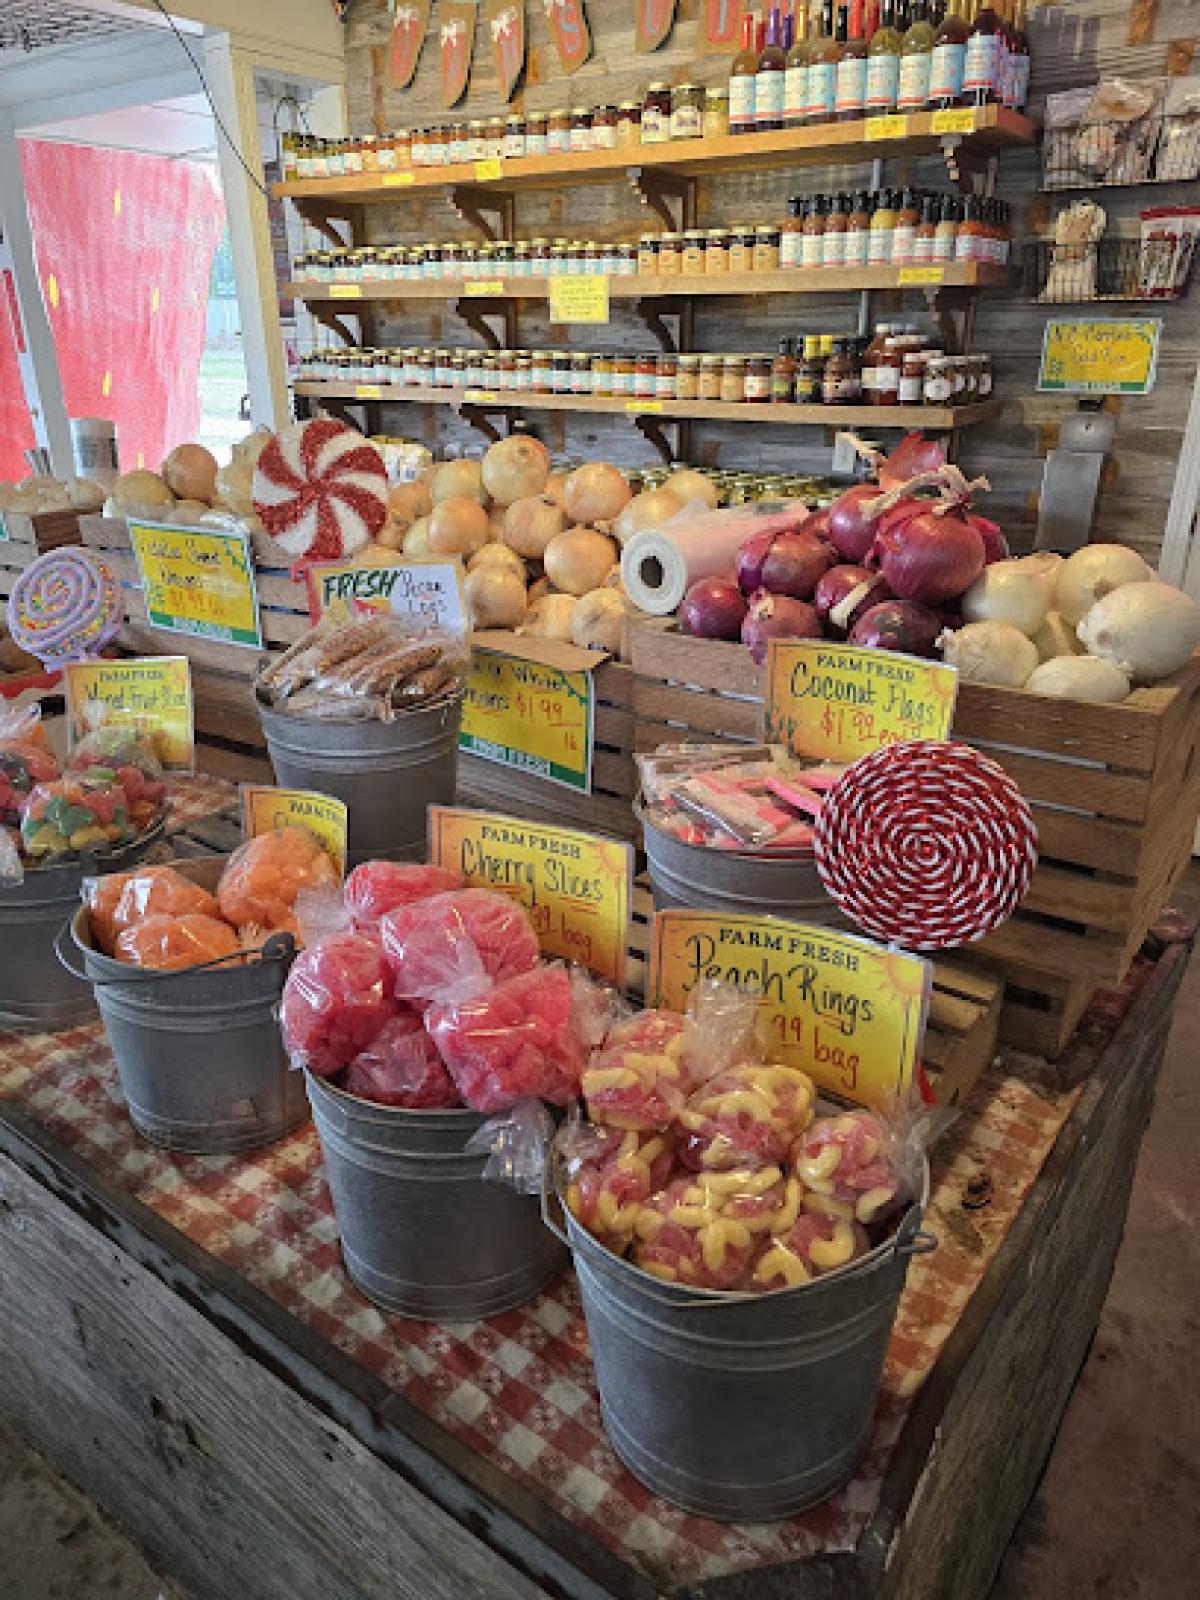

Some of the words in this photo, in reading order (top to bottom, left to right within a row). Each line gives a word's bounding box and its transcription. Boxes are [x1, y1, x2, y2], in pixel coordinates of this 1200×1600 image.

[322, 570, 400, 606] FRESH
[790, 660, 877, 706] Coconut
[817, 655, 864, 673] FARM
[866, 661, 915, 683] FRESH
[821, 703, 879, 745] $1.99
[481, 826, 525, 847] FARM
[528, 834, 580, 860] FRESH
[461, 837, 536, 907] Cherry
[544, 858, 604, 901] Slices
[561, 911, 592, 963] bag
[720, 928, 783, 951] FARM
[788, 937, 860, 972] FRESH
[682, 932, 786, 1004] Peach
[787, 963, 874, 1036] Rings
[814, 1023, 860, 1092] bag
